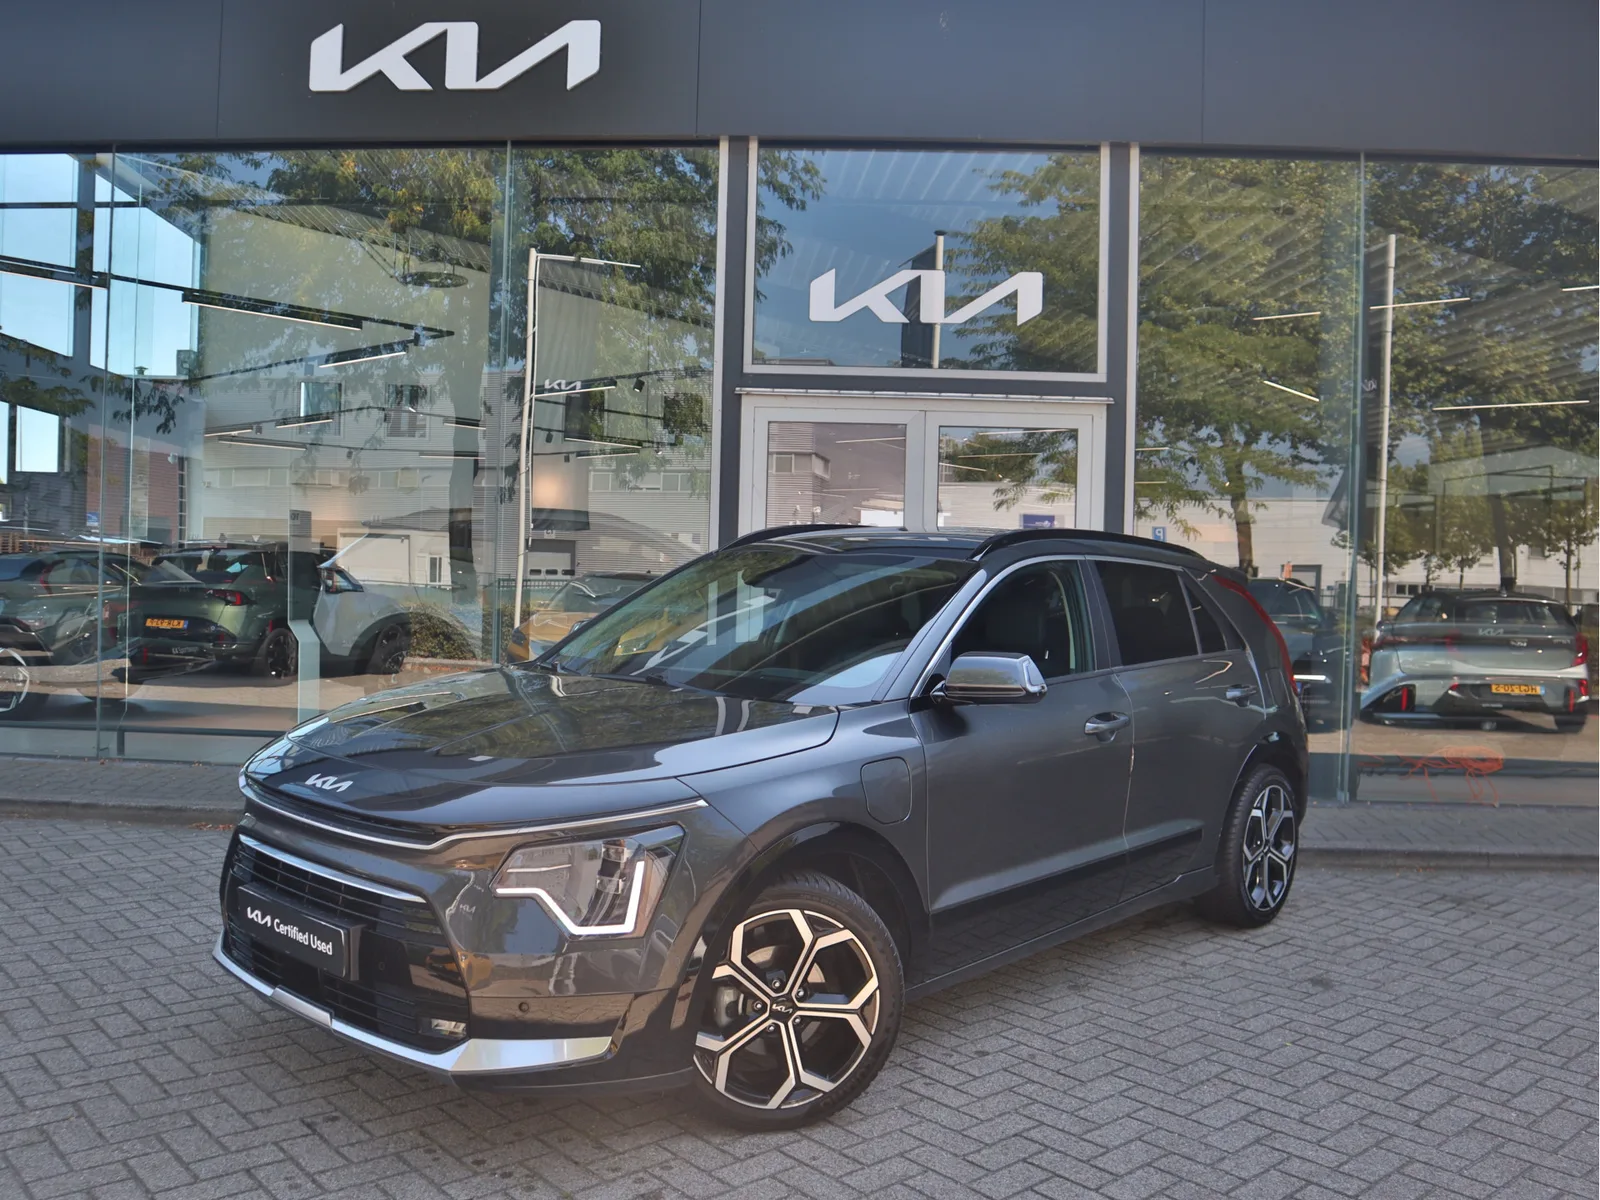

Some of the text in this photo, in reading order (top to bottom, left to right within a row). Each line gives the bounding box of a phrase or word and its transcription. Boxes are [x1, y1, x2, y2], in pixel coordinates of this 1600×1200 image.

[309, 20, 601, 92] KIA
[809, 268, 1043, 326] KIA
[544, 378, 582, 391] KIA
[305, 773, 354, 793] KIA
[246, 906, 333, 956] KIA Certified Used
[771, 1003, 794, 1014] KIA
